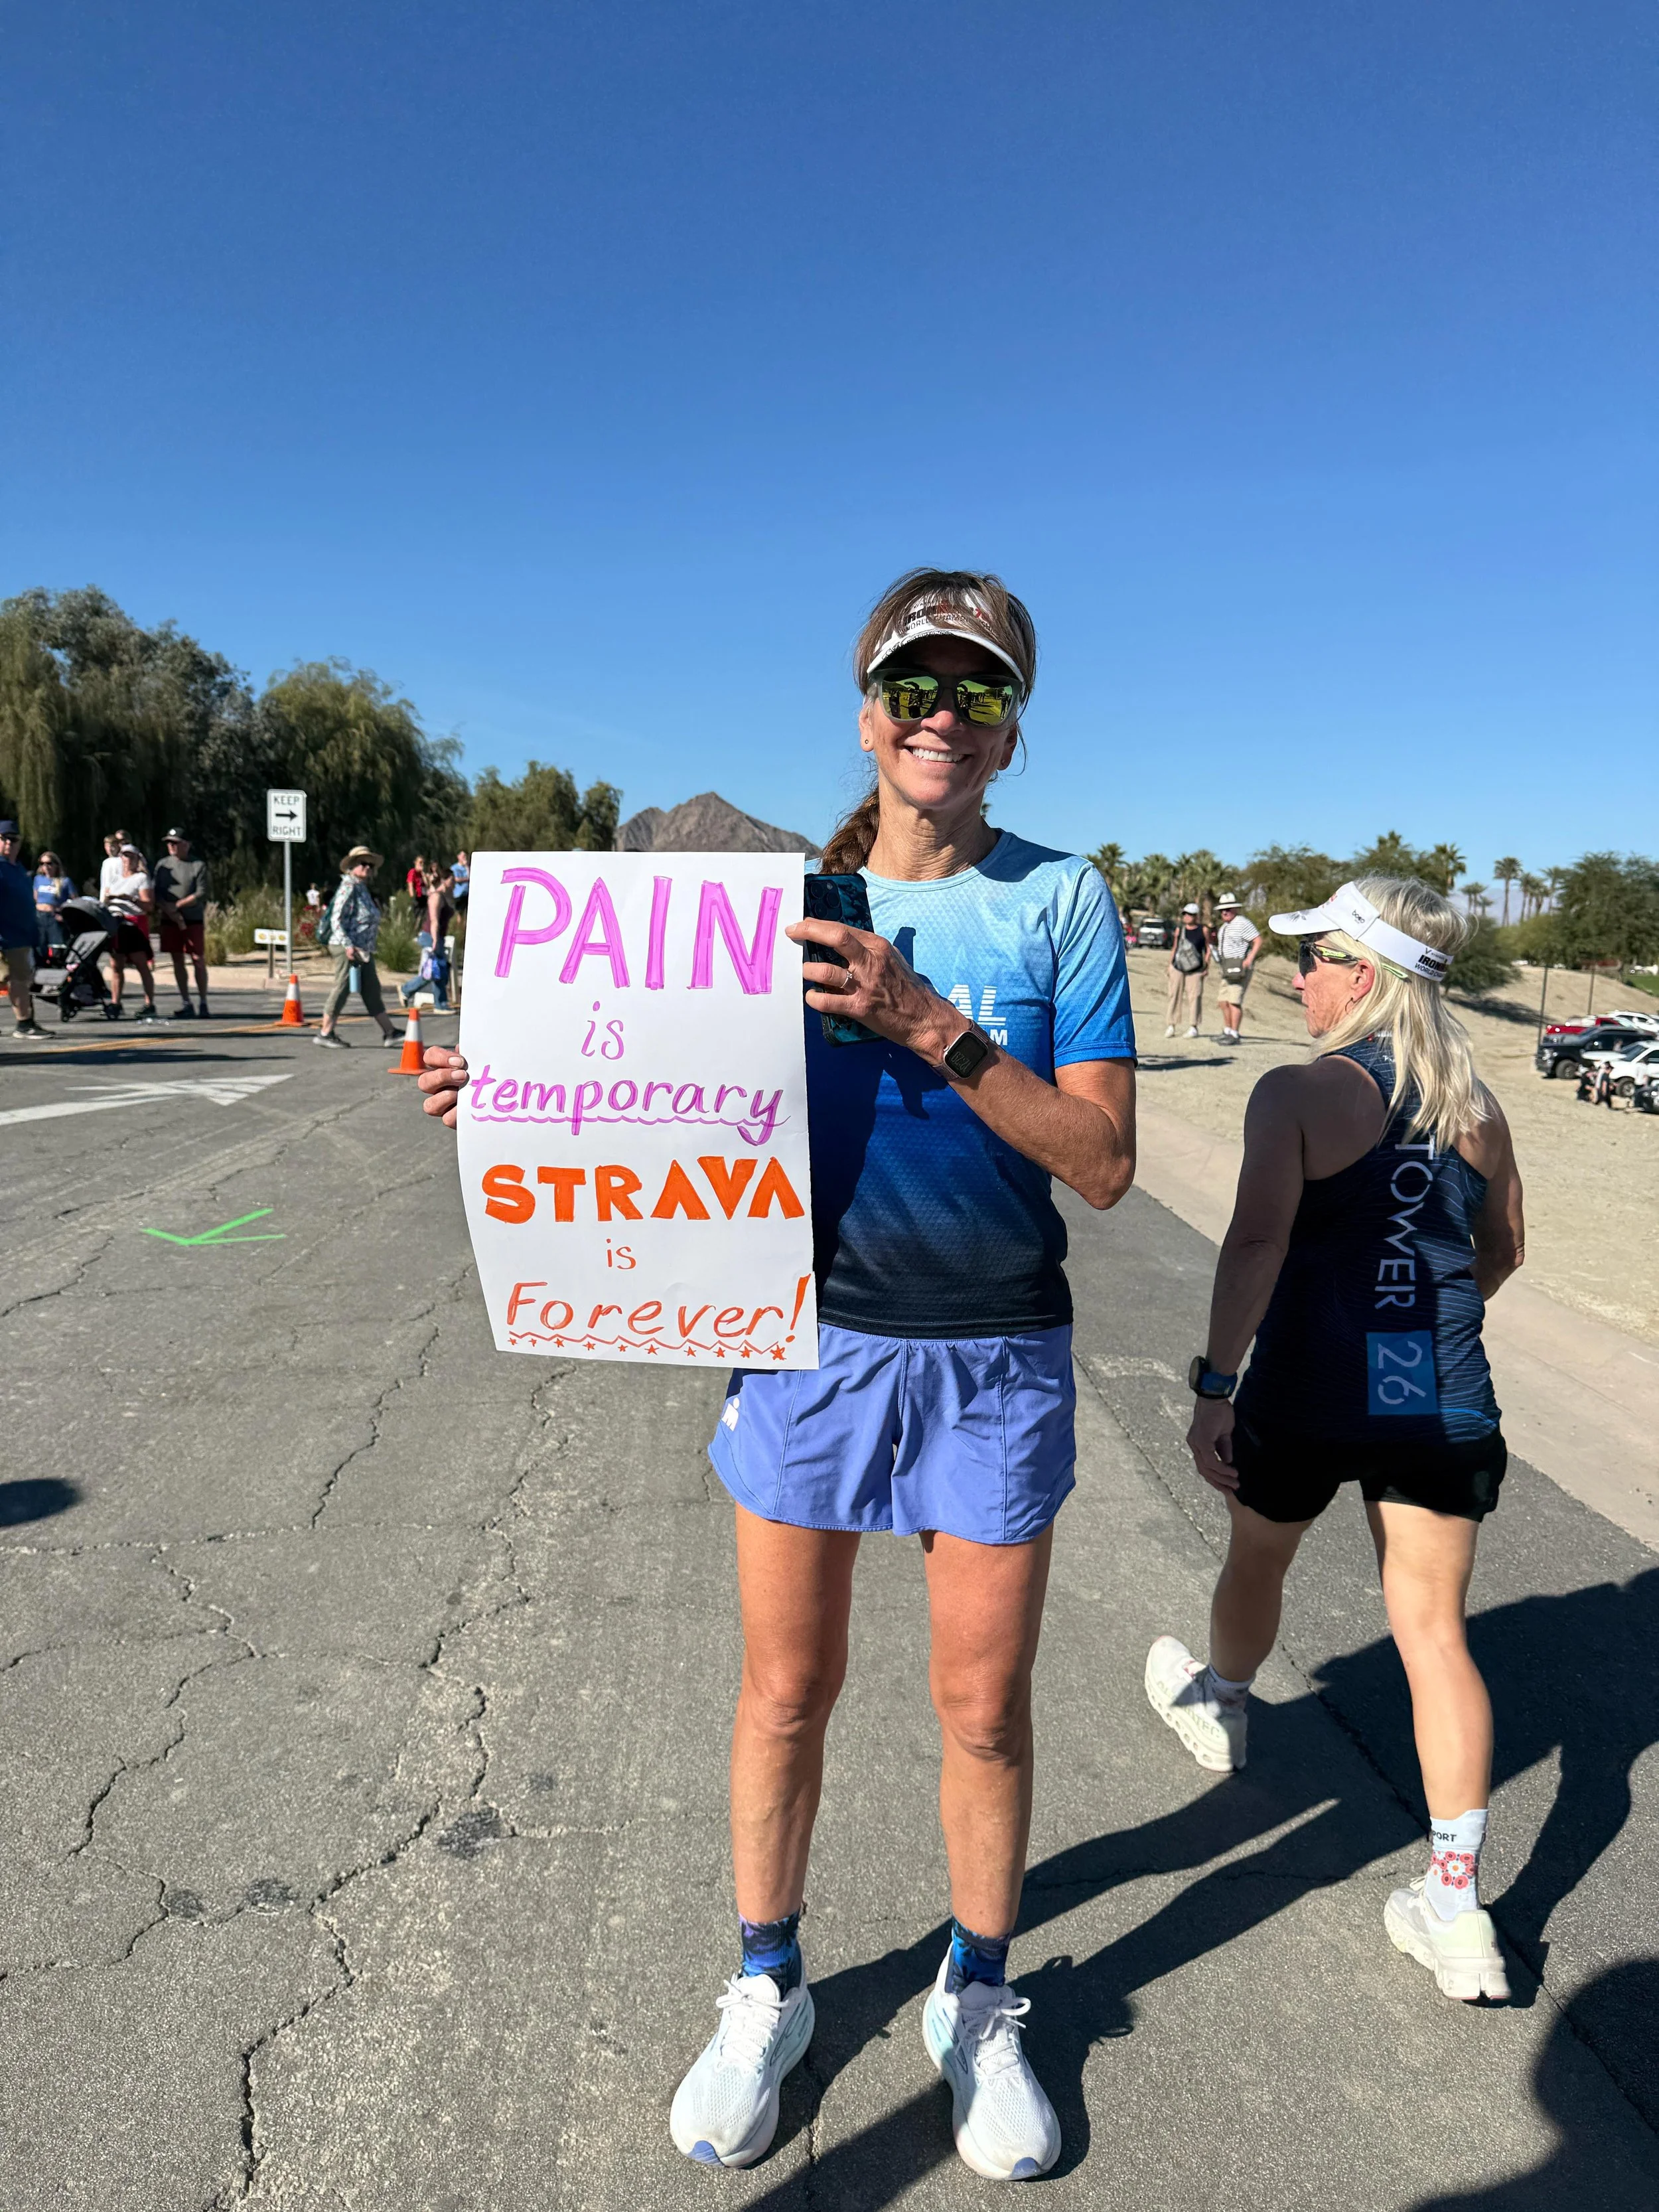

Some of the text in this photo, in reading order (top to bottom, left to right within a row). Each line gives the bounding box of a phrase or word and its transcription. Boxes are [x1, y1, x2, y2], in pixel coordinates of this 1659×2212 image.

[273, 796, 300, 805] KEEP
[273, 826, 301, 836] RIGHT
[494, 867, 783, 995] PAIN
[1418, 954, 1447, 972] IRON
[581, 1001, 624, 1060] is
[470, 1065, 784, 1146] temporary
[481, 1155, 806, 1224] STRAVA
[606, 1238, 637, 1270] is
[1374, 1135, 1435, 1405] TOWER 26
[507, 1274, 811, 1343] Forever!
